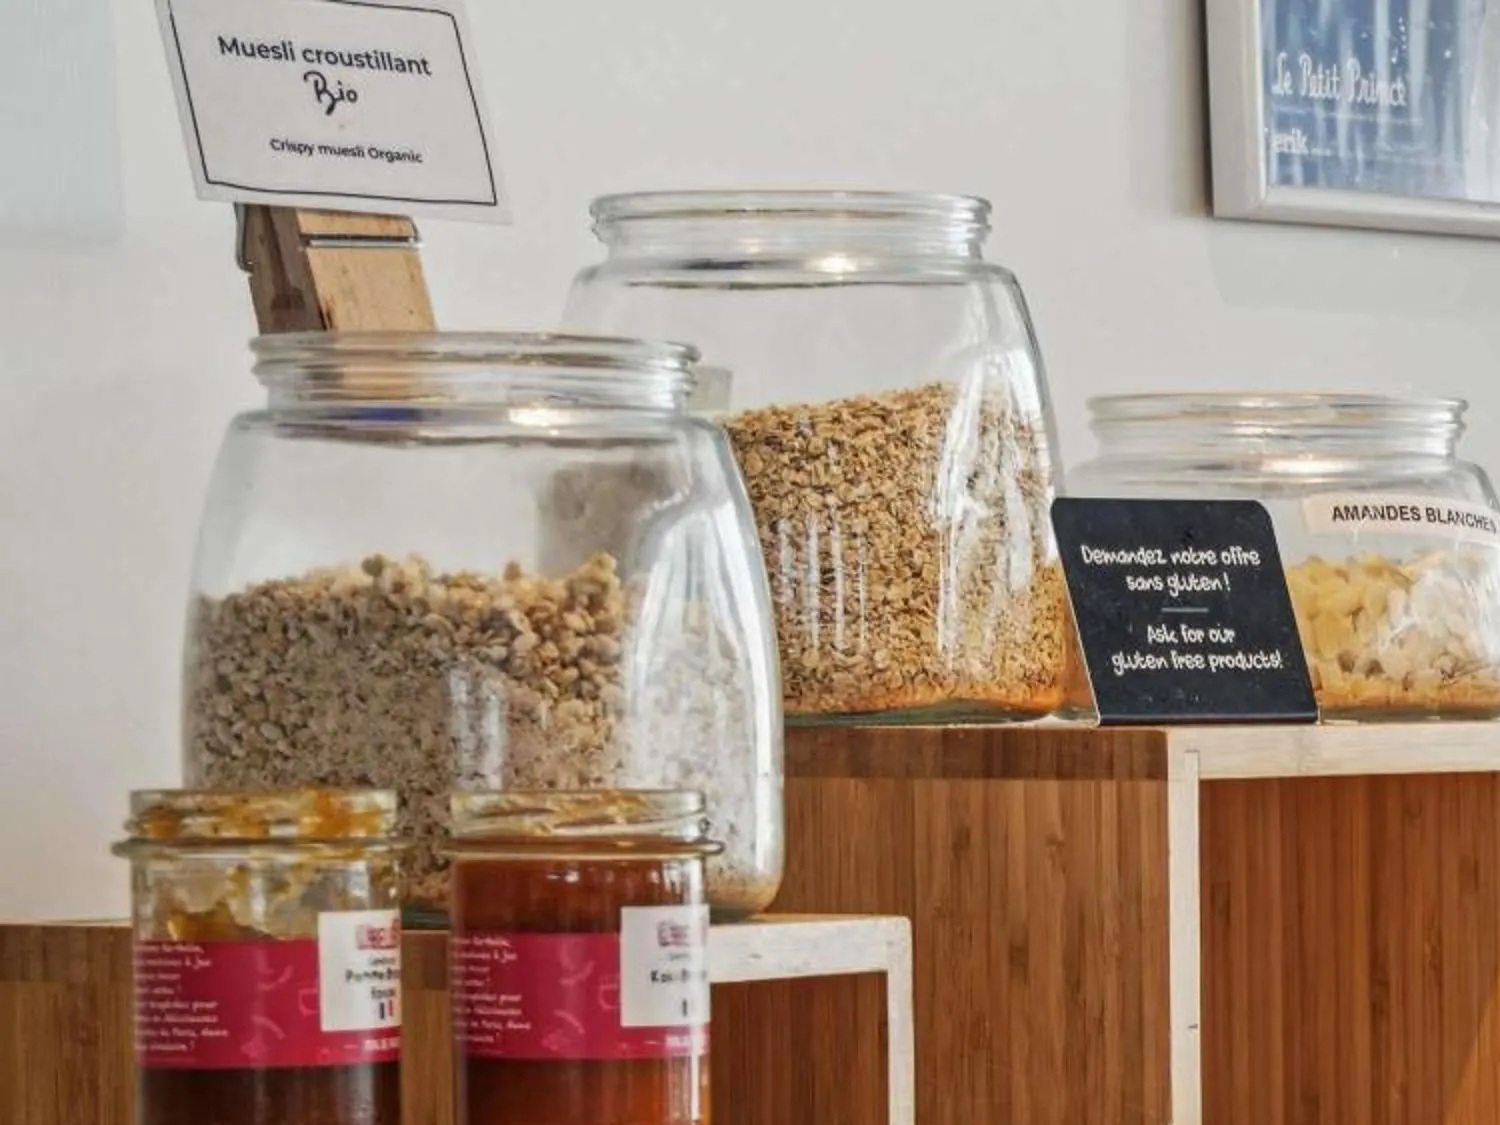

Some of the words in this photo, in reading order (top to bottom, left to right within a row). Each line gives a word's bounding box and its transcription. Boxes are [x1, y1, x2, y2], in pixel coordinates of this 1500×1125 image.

[217, 35, 296, 62] Muesli
[302, 47, 432, 76] croustillant
[1298, 51, 1340, 99] Petit
[1346, 56, 1407, 107] Prince
[303, 70, 358, 116] Bio
[270, 138, 314, 156] Crispy
[318, 143, 365, 159] muesli
[367, 147, 423, 164] Organic
[1332, 505, 1421, 523] AMANDES
[1080, 546, 1167, 566] Demandez
[1171, 547, 1217, 566] notre
[1221, 546, 1261, 565] offre
[1126, 575, 1163, 591] sans
[1147, 624, 1178, 644] Ask
[1180, 624, 1204, 643] for
[1209, 627, 1235, 644] our
[1112, 652, 1169, 675] gluten
[1170, 650, 1206, 669] free
[1208, 650, 1284, 673] products!
